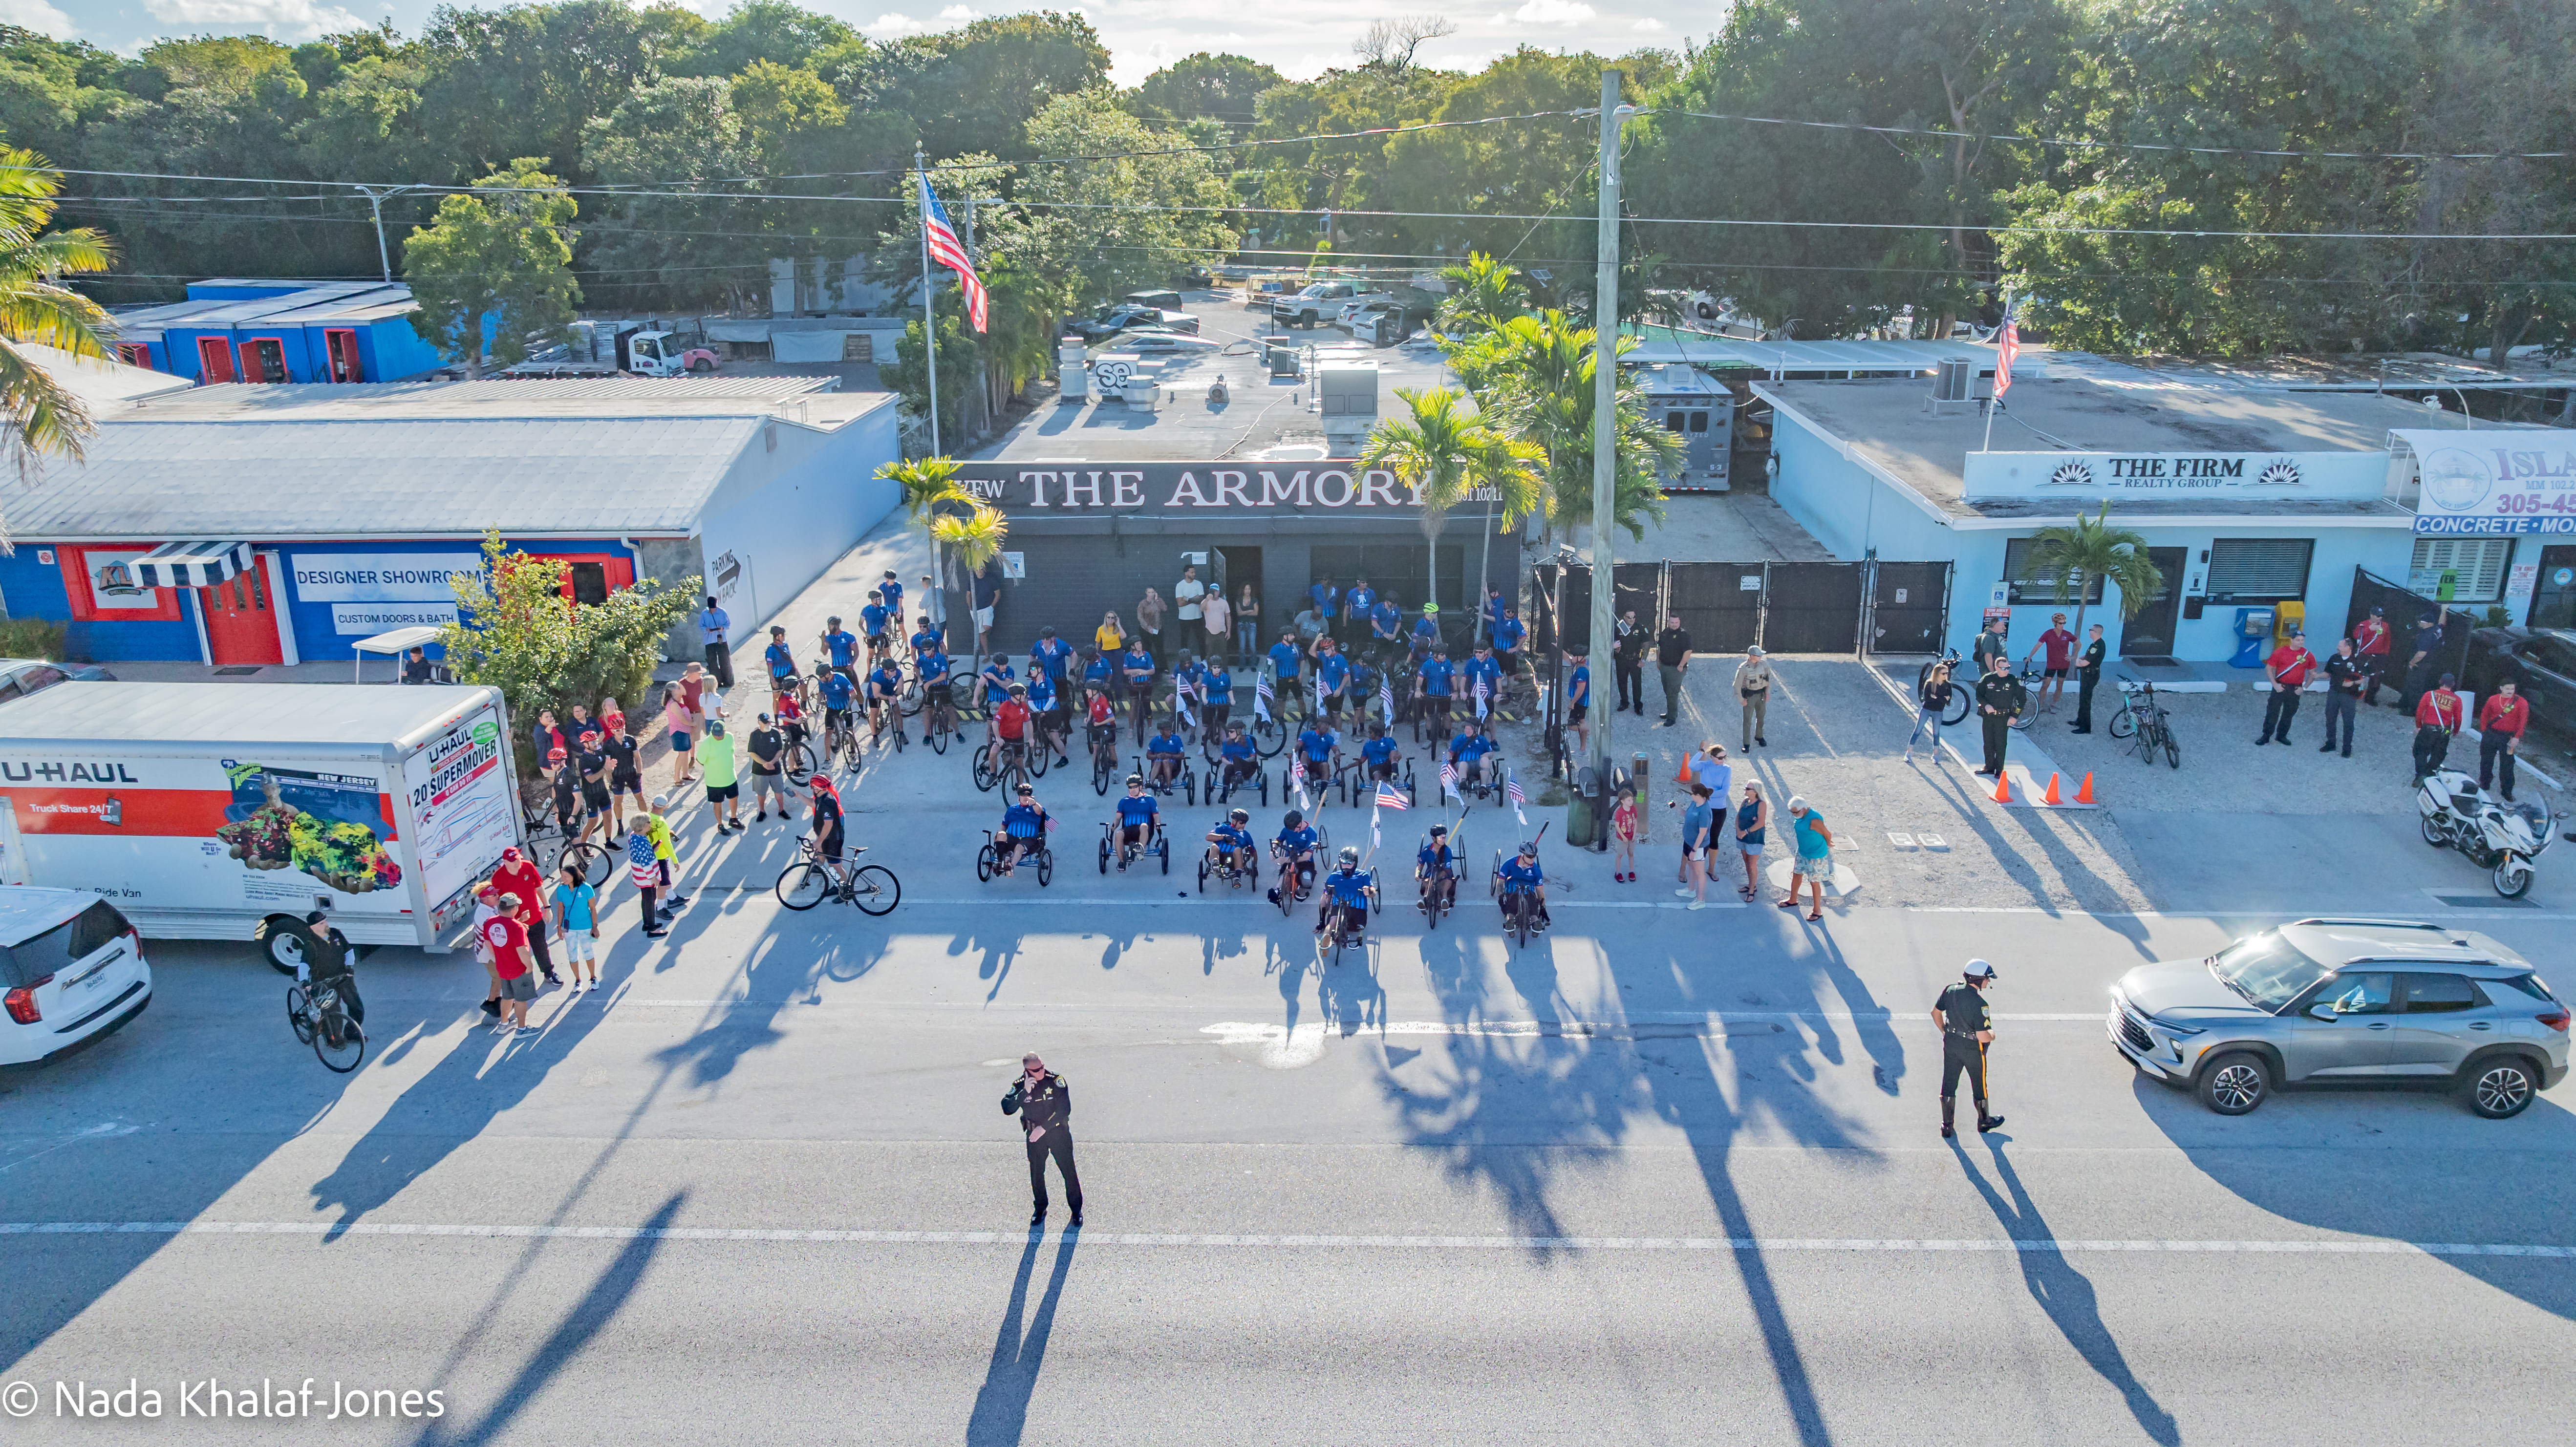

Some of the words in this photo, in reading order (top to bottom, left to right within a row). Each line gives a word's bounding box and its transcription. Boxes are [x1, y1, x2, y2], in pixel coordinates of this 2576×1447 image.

[2109, 458, 2167, 477] THE
[2173, 458, 2246, 477] FIRM
[1019, 471, 1145, 507] THE
[2125, 479, 2176, 488] REALTY
[2178, 479, 2222, 488] GROUP
[2526, 481, 2545, 489] MM
[2416, 517, 2530, 532] CONCRETE
[2539, 518, 2576, 533] MO
[712, 549, 733, 576] PARKING
[297, 571, 378, 584] DESIGNER
[716, 590, 722, 605] IN
[722, 579, 737, 604] BACK
[338, 615, 380, 623] CUSTOM
[383, 615, 415, 623] DOORS
[418, 615, 425, 623] &
[428, 614, 454, 623] BATH
[429, 729, 472, 764] U-HAUL
[1, 762, 139, 783] U-HAUL
[318, 774, 338, 782] NEW
[341, 776, 375, 786] JERSEY
[29, 804, 58, 813] Truck
[61, 804, 88, 813] Share
[90, 804, 114, 815] 24/7
[95, 888, 118, 897] Ride
[122, 888, 141, 898] Van
